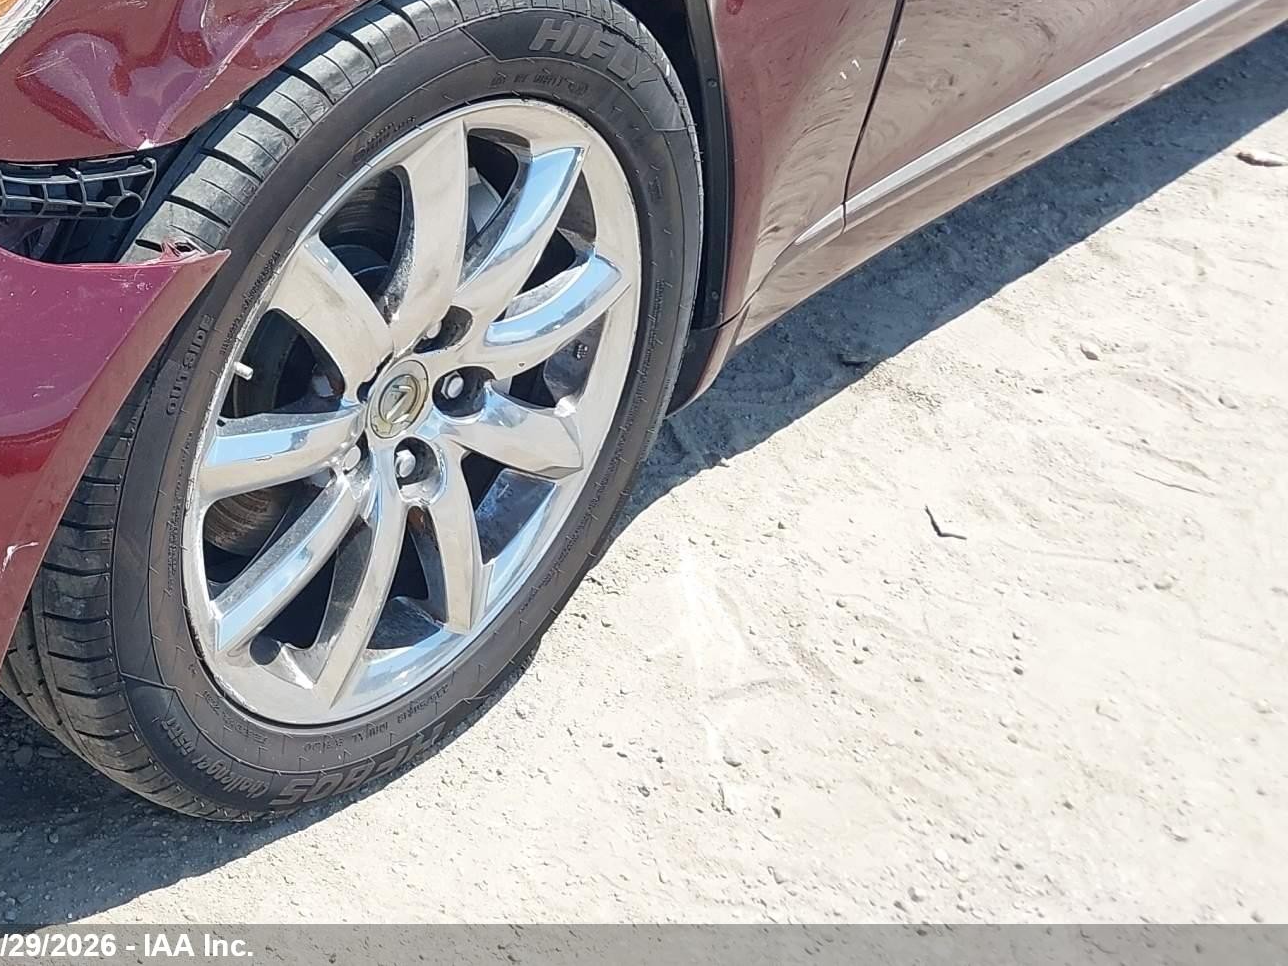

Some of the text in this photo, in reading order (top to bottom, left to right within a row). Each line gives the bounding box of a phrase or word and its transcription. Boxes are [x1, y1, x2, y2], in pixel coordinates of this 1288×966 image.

[528, 18, 659, 90] HIFLY
[166, 314, 214, 416] OUTSIDE
[191, 754, 270, 799] Challenger
